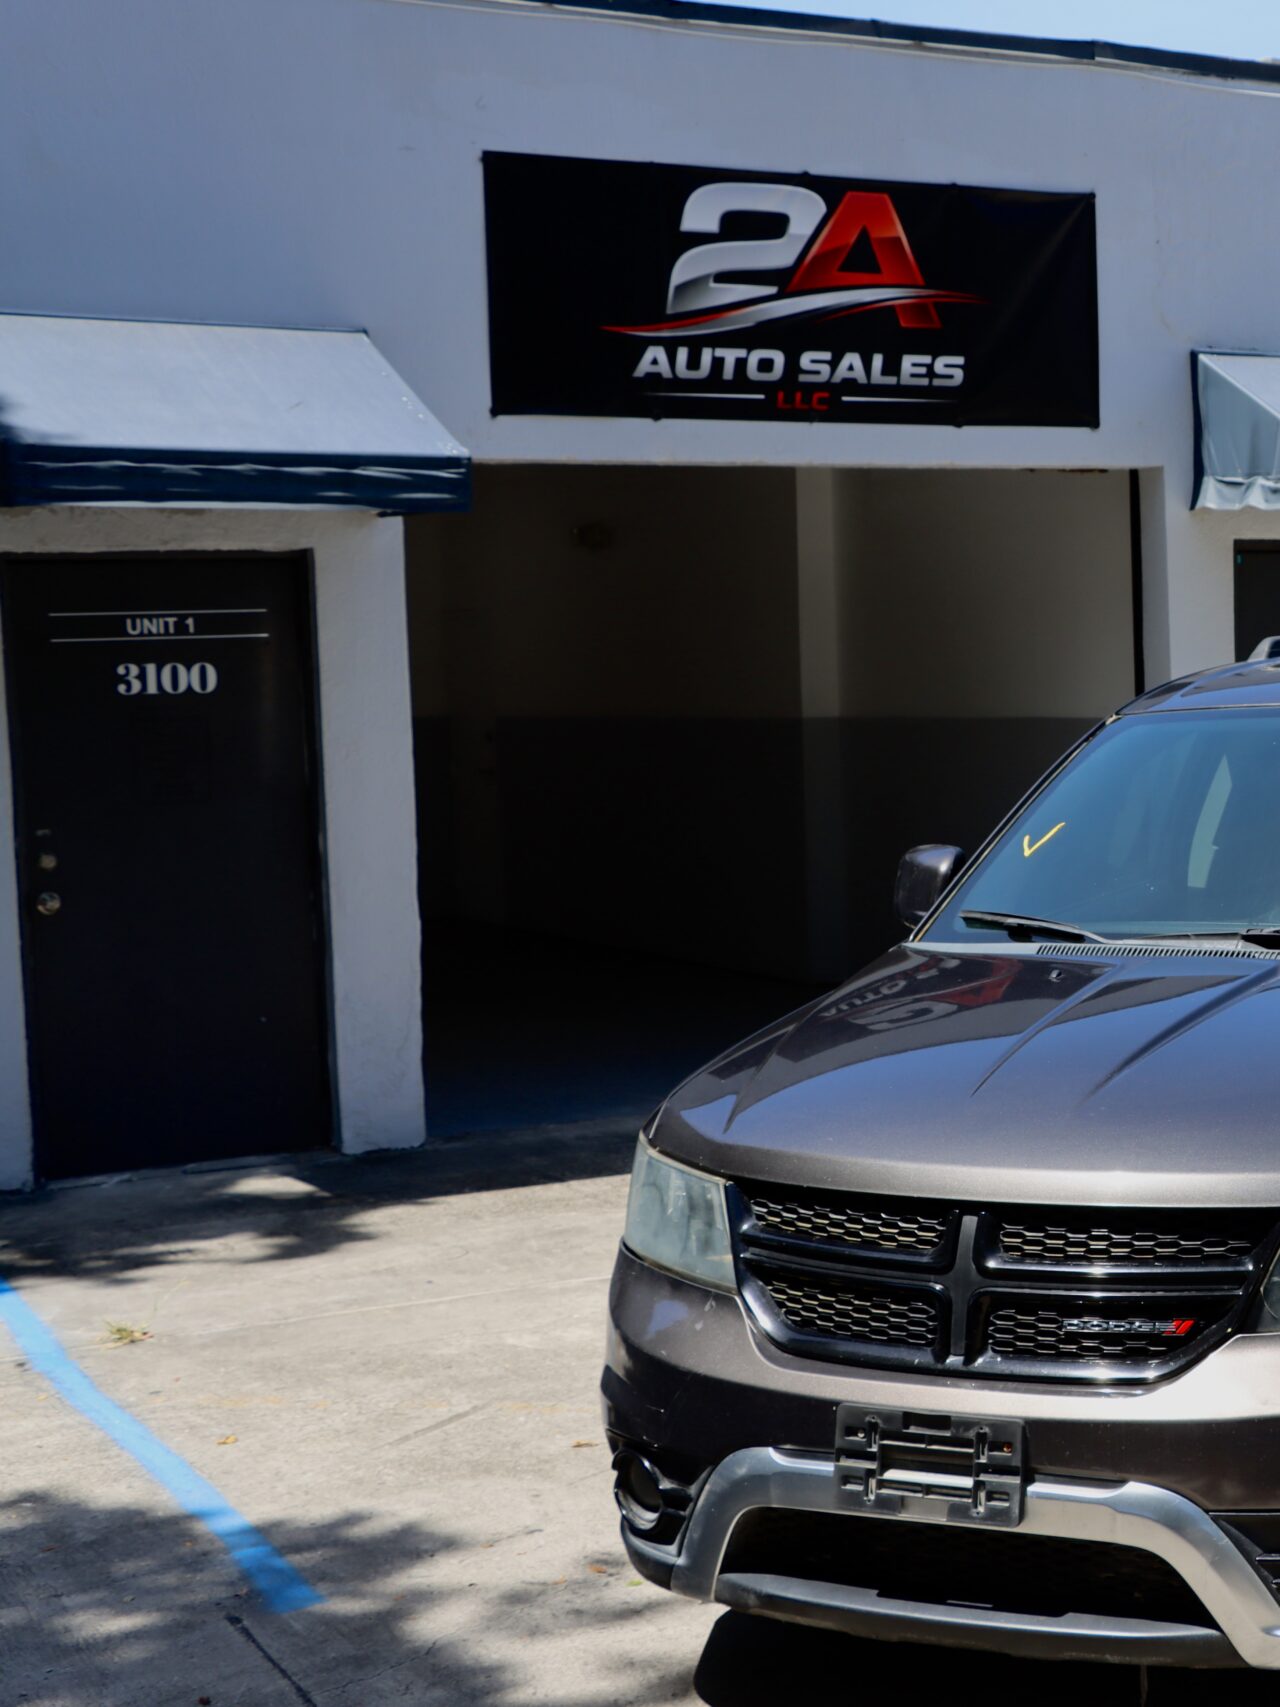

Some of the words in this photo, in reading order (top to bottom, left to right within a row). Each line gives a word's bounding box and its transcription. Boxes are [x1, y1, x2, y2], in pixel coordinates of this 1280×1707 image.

[667, 181, 942, 329] 2A
[632, 345, 785, 380] AUTO
[798, 350, 965, 387] SALES
[776, 391, 830, 411] LLC
[126, 617, 178, 635] UNIT
[185, 617, 195, 633] 1
[116, 662, 218, 695] 3100
[1062, 1319, 1177, 1332] DODGE
